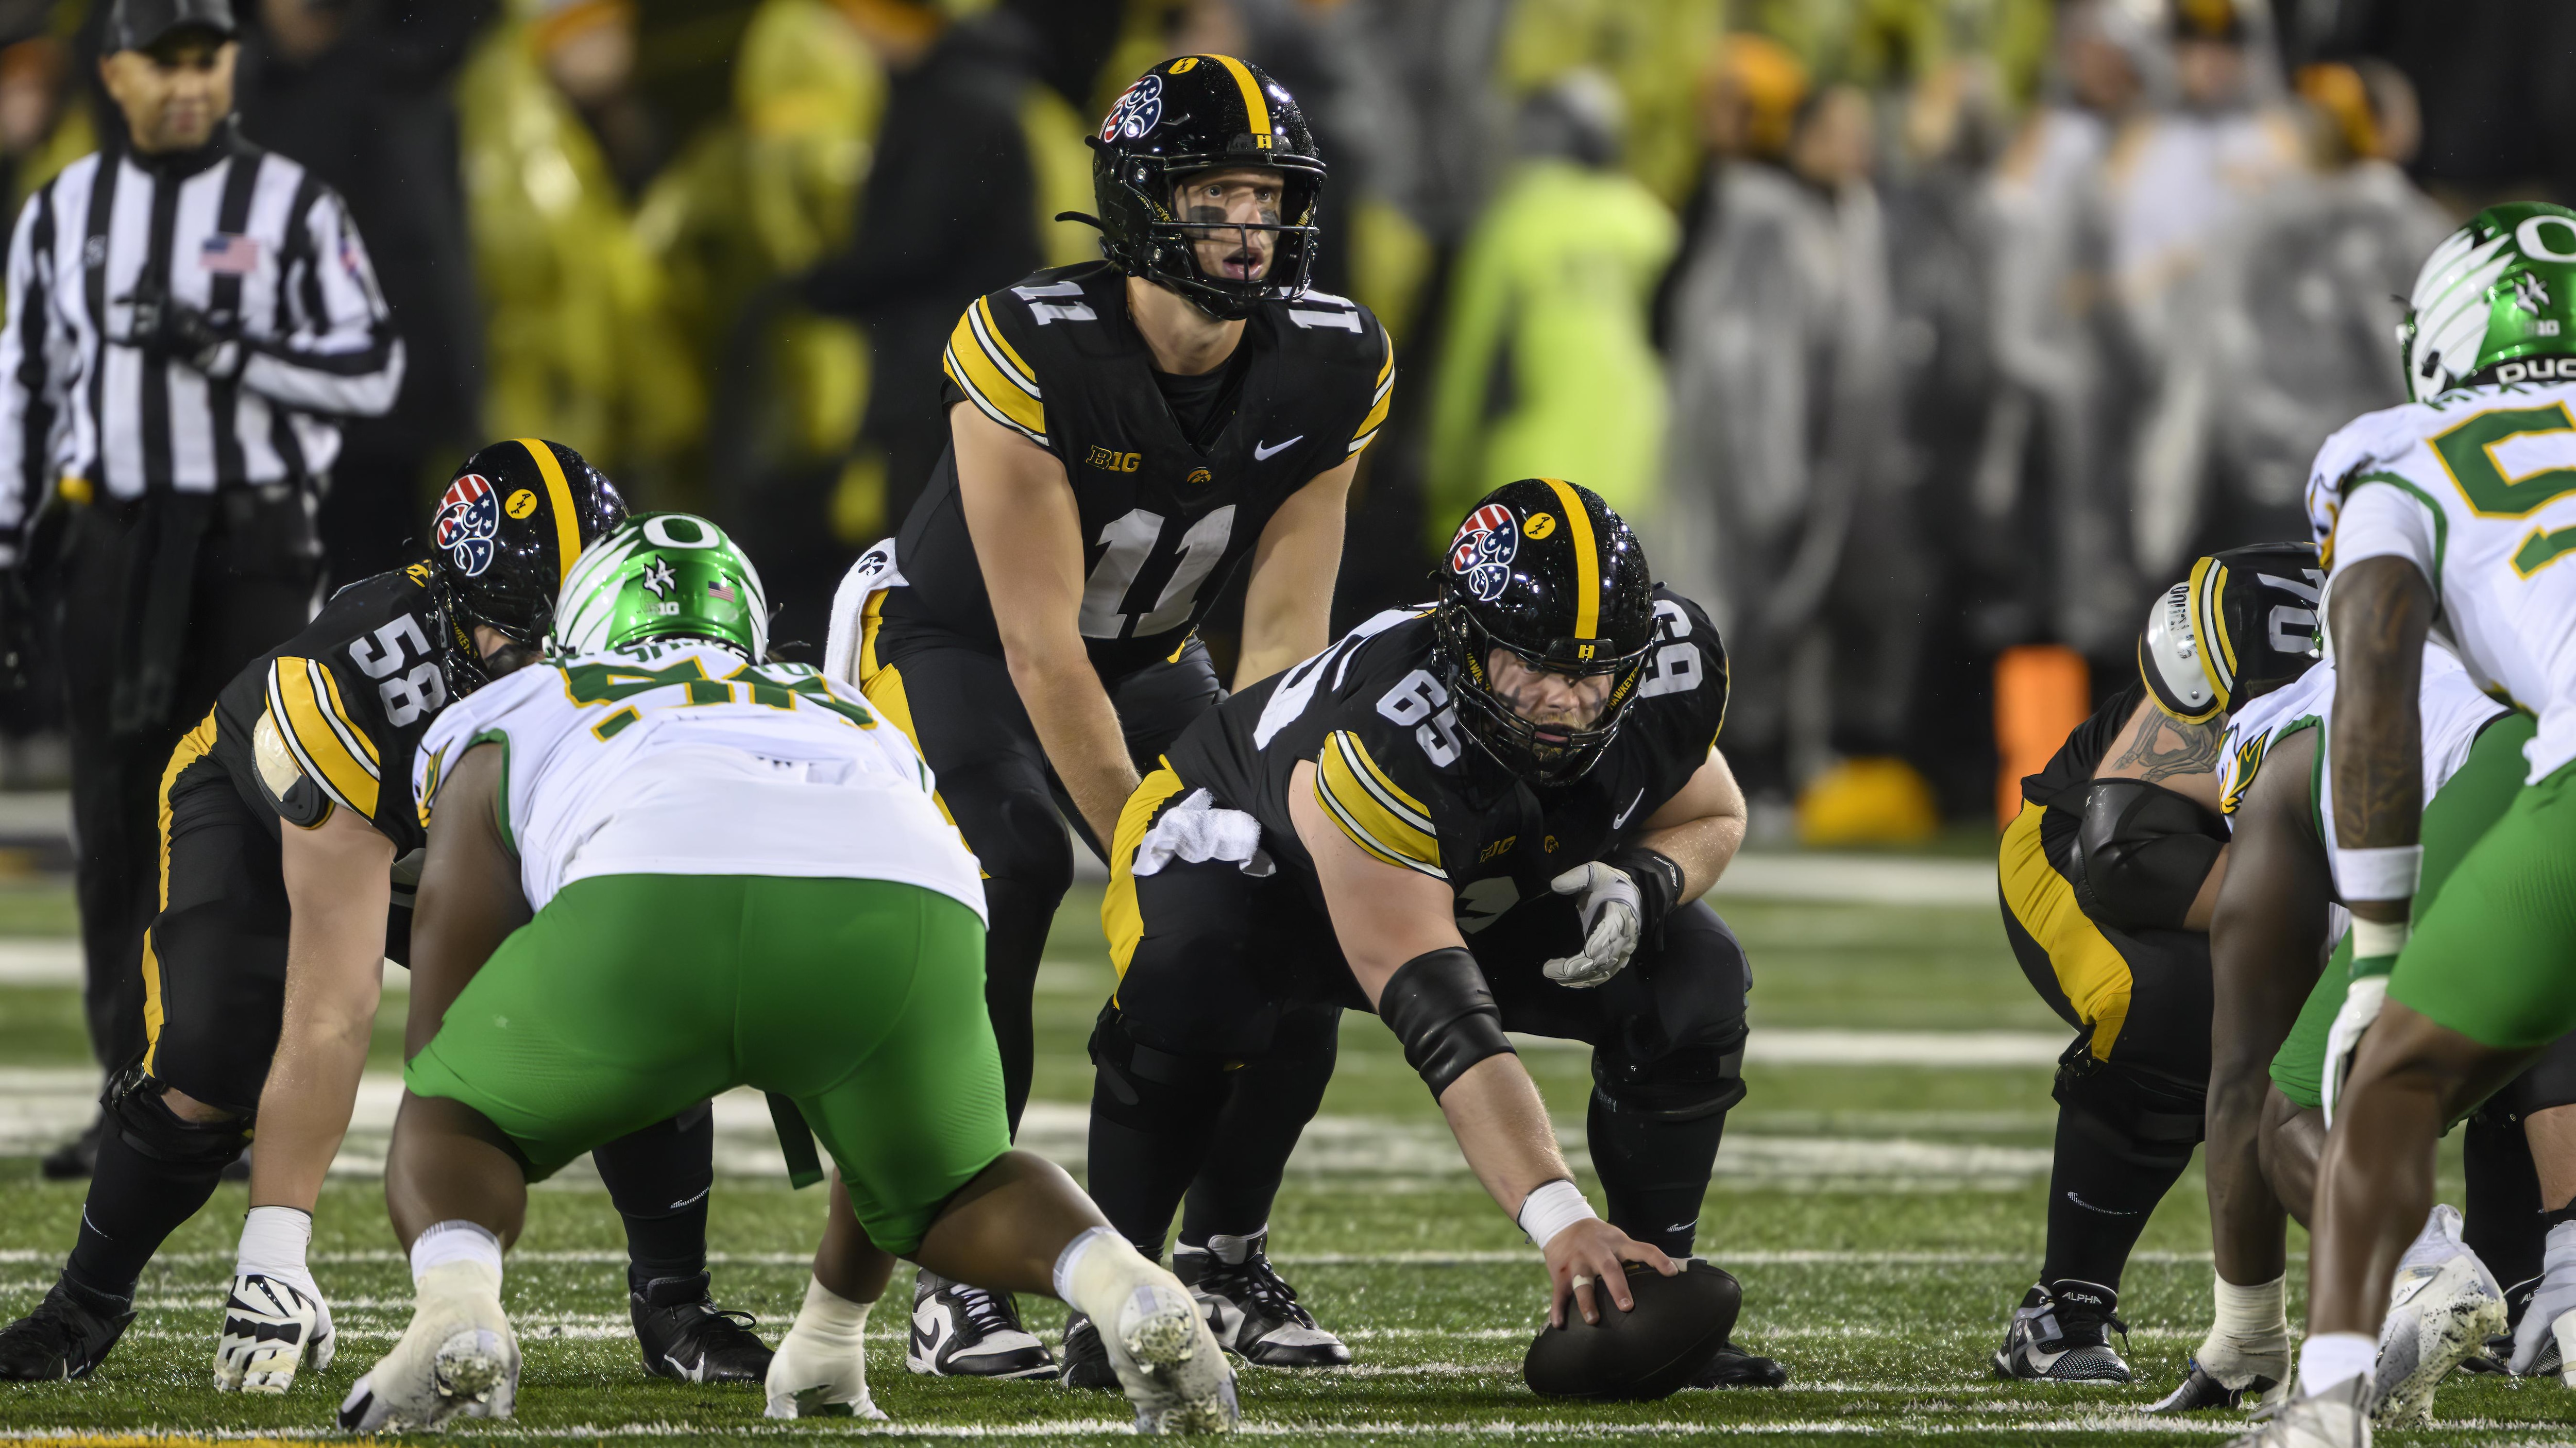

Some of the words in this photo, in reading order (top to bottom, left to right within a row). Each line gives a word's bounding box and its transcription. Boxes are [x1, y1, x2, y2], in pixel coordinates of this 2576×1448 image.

[1010, 280, 1098, 326] 11
[643, 514, 720, 549] O
[1078, 504, 1236, 639] 11
[2257, 568, 2327, 655] 70
[349, 612, 447, 728] 58
[1376, 669, 1462, 768] 65
[2062, 1291, 2102, 1305] ALPHA
